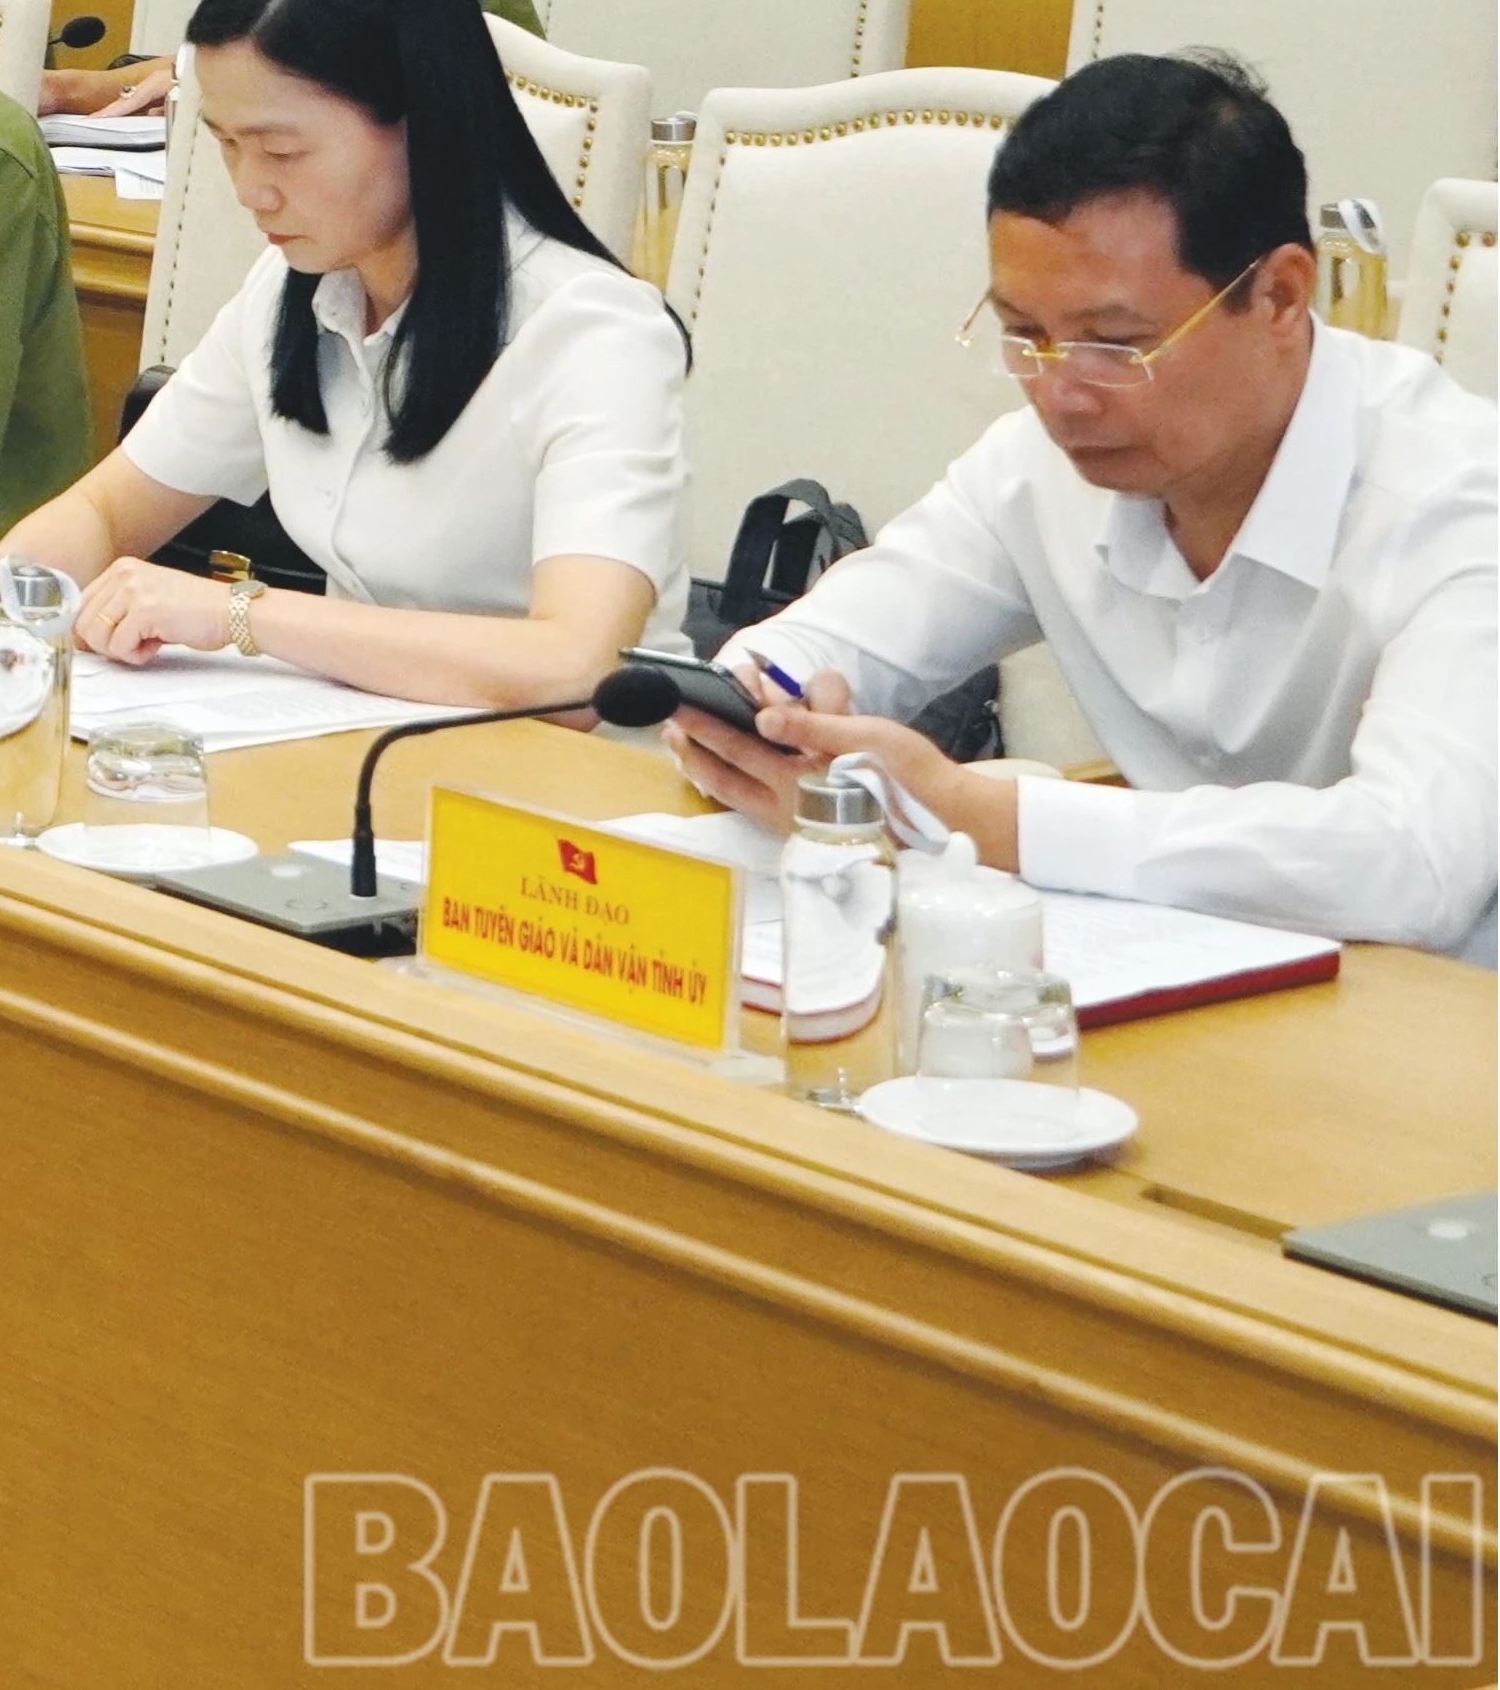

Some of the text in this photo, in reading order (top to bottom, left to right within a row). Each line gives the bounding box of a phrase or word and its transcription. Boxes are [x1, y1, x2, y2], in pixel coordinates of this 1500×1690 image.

[443, 897, 470, 934] BAN
[519, 917, 555, 958] GIÁO
[560, 927, 579, 965] VÀ
[583, 933, 613, 977] DÂN
[617, 944, 647, 994] VẬN
